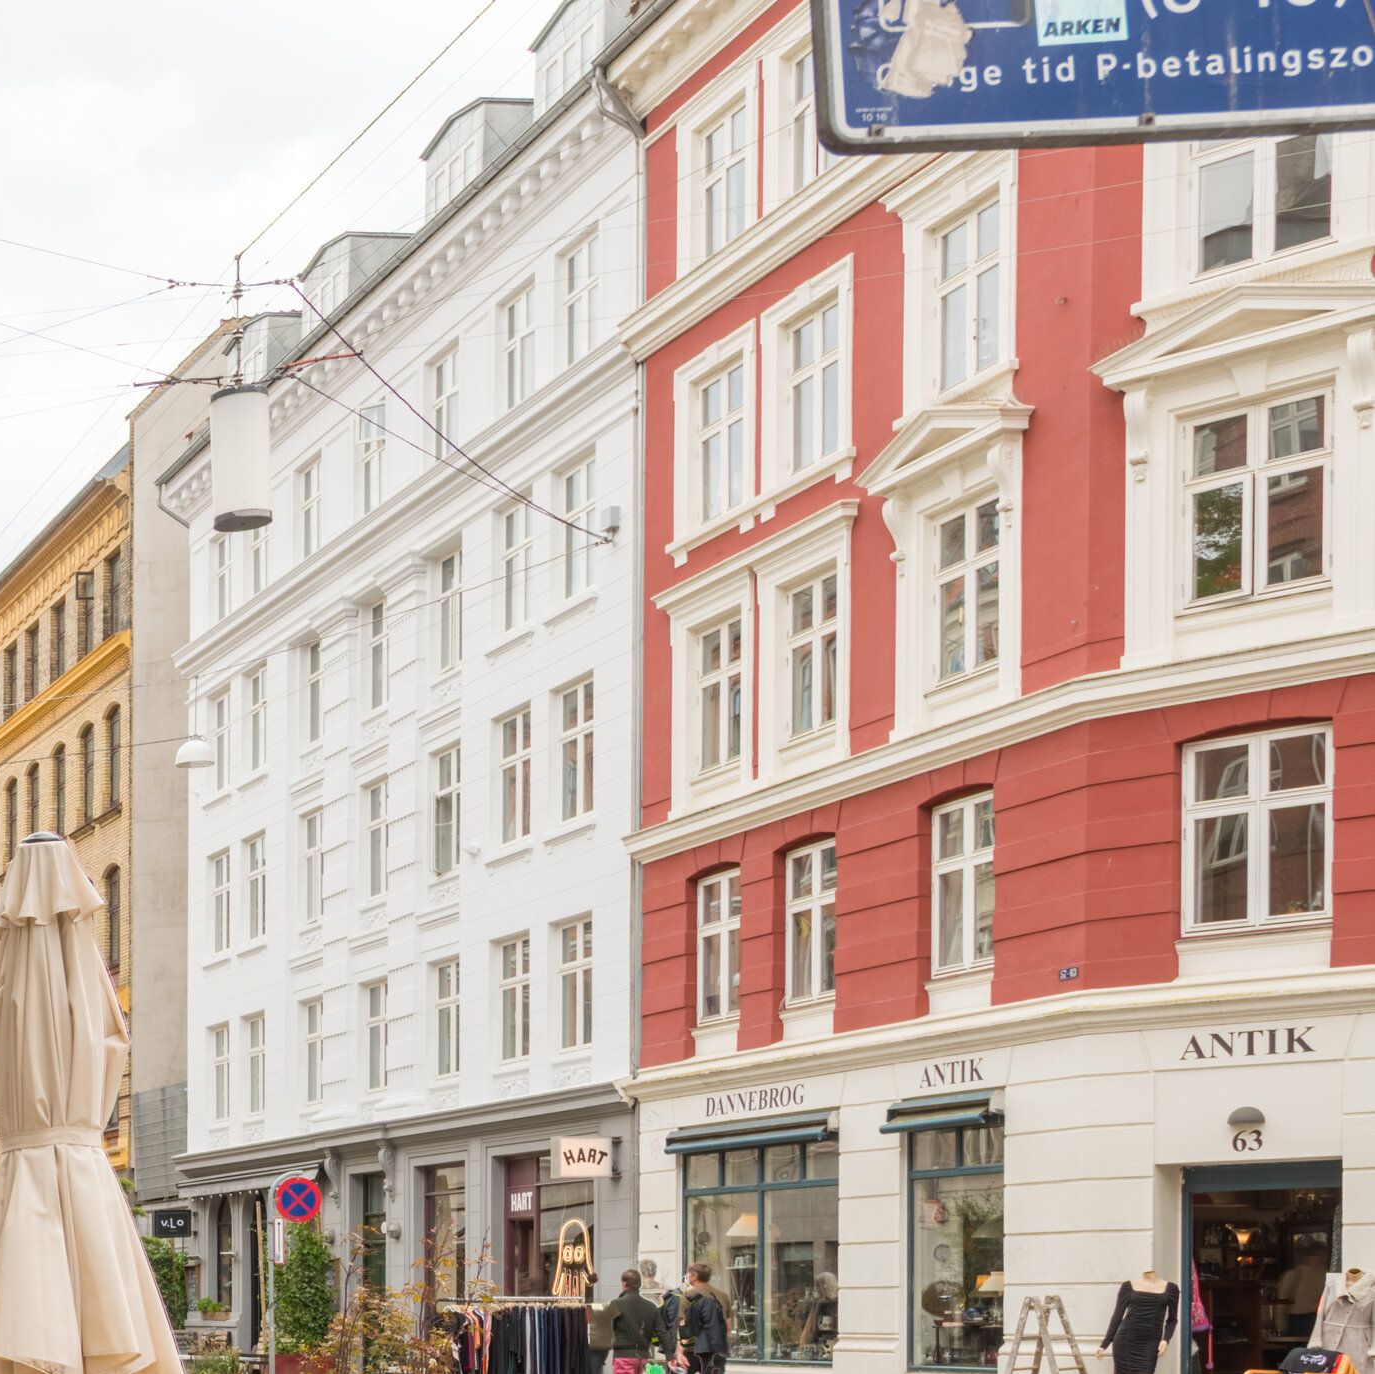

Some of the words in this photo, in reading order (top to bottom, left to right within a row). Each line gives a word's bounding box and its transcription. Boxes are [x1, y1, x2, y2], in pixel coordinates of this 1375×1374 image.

[1043, 19, 1121, 38] ARKEN
[1022, 55, 1075, 85] tid
[861, 112, 873, 122] 10
[1179, 1026, 1317, 1061] ANTIK
[920, 1057, 984, 1089] ANTIK
[706, 1084, 805, 1117] DANNEBROG
[1232, 1129, 1264, 1152] 63
[563, 1147, 609, 1166] HART
[511, 1191, 533, 1212] HART
